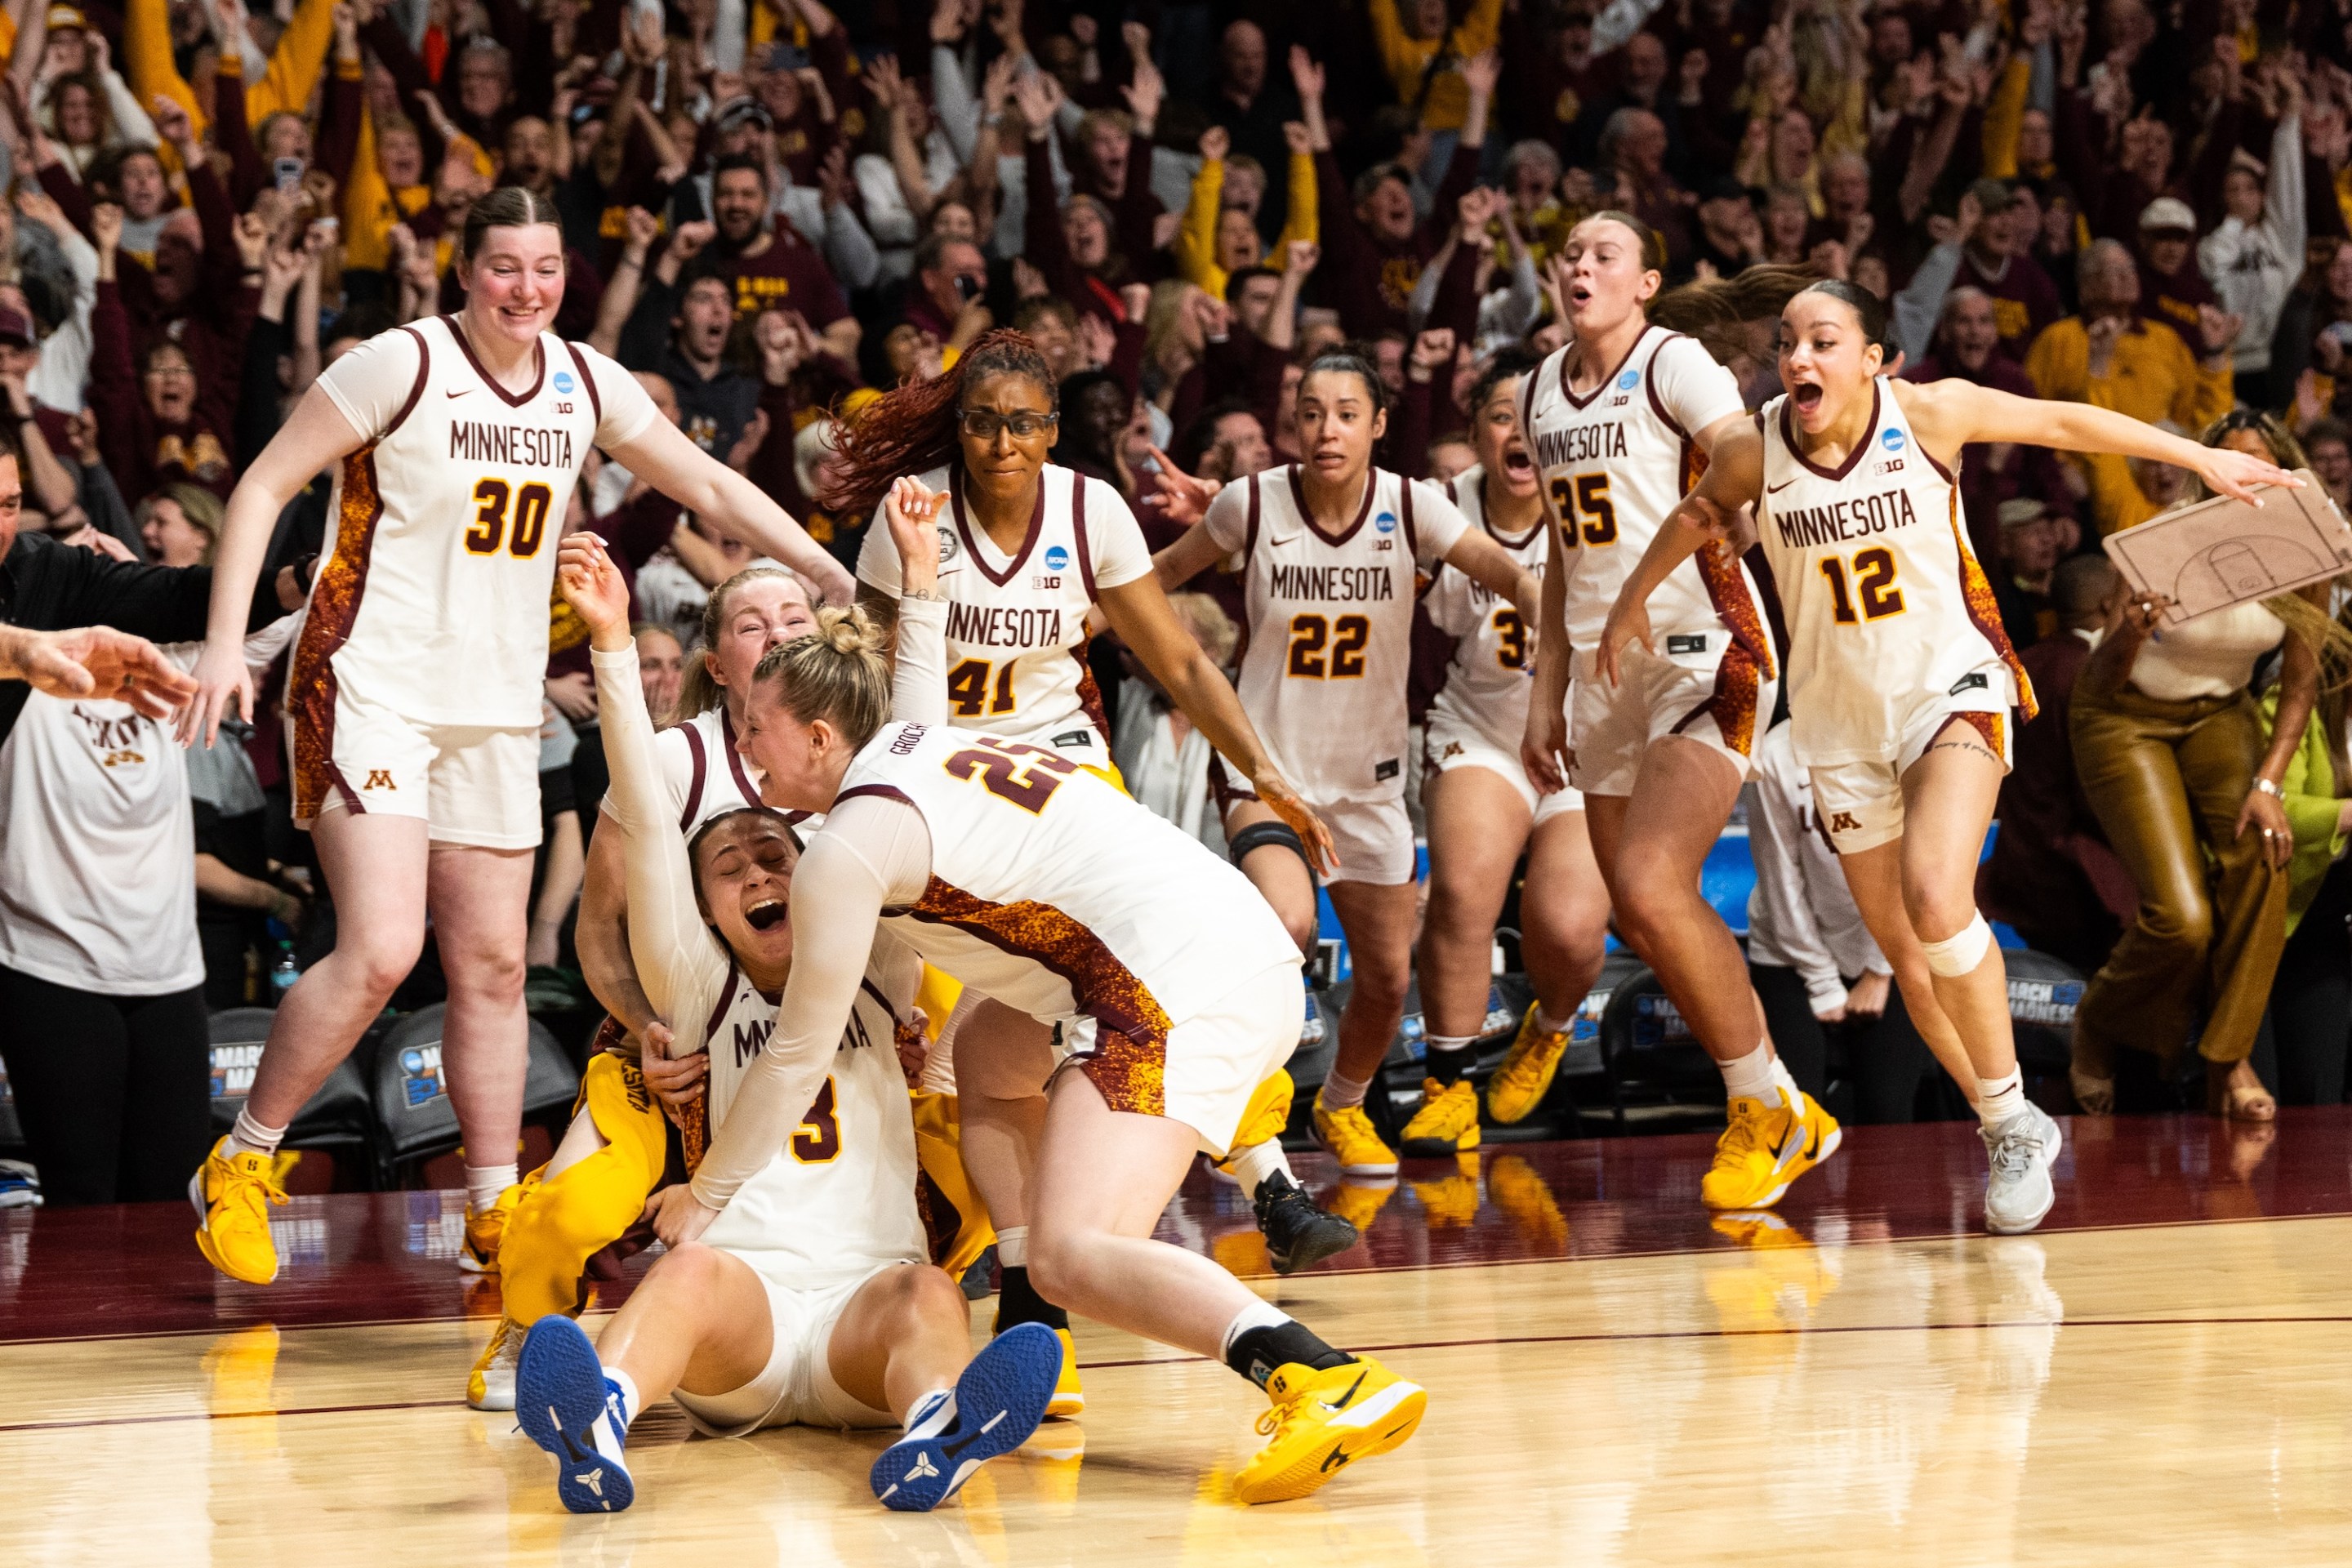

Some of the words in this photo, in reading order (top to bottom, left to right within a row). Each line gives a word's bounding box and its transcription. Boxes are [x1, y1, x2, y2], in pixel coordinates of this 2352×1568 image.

[450, 420, 572, 469] MINNESOTA
[1535, 421, 1628, 470] MINNESOTA
[464, 476, 553, 559] 30
[1551, 471, 1619, 549] 35
[1775, 488, 1917, 548] MINNESOTA
[1271, 563, 1392, 601] MINNESOTA
[1818, 546, 1907, 626] 12
[945, 599, 1060, 648] INNESOTA
[1288, 612, 1371, 680] 22
[948, 657, 1020, 718] 41
[889, 721, 931, 755] GROCH
[363, 770, 397, 791] M
[942, 737, 1083, 817] 25
[1832, 812, 1863, 833] M
[789, 1074, 843, 1165] 3
